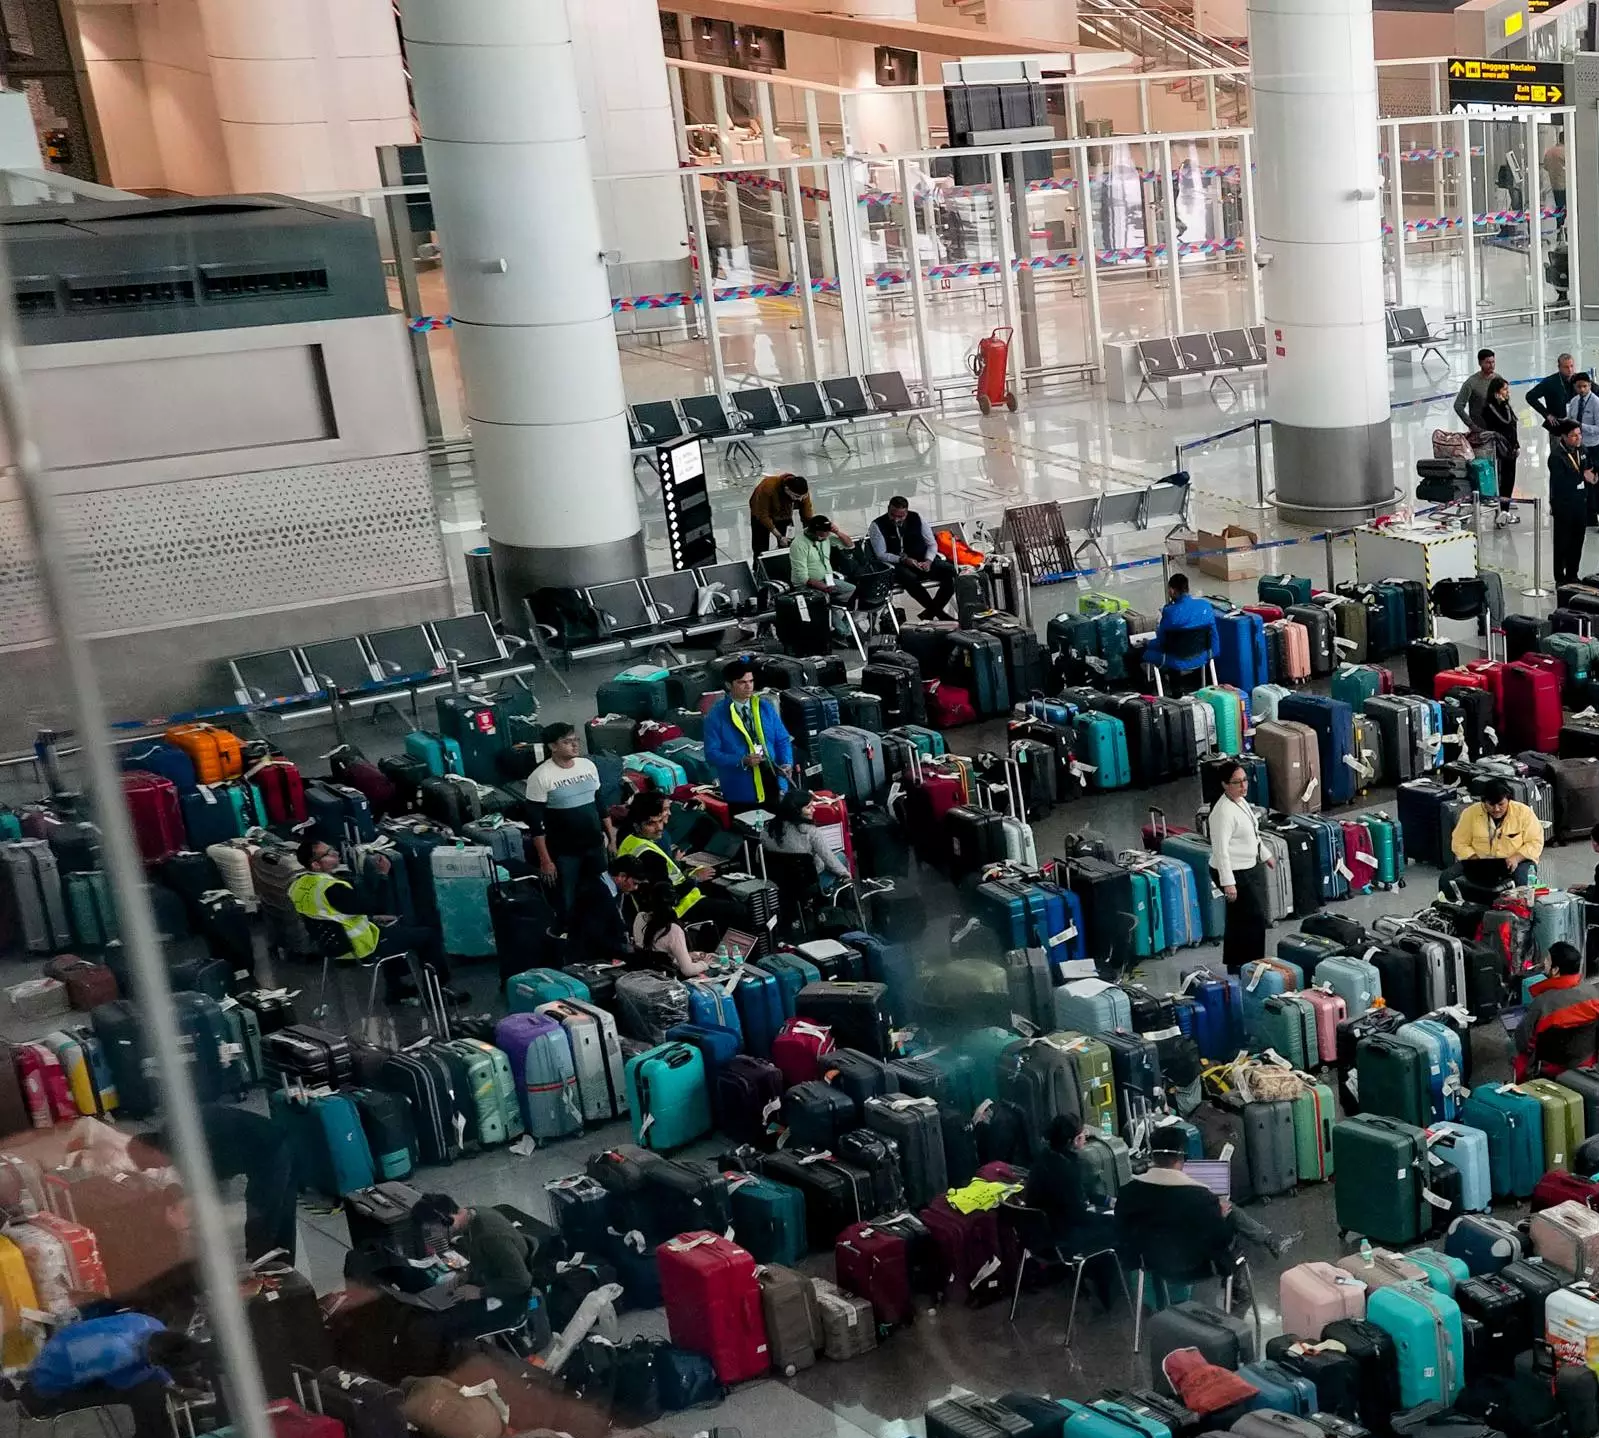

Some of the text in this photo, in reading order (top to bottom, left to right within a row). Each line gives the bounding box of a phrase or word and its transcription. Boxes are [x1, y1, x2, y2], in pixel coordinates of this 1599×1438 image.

[1481, 62, 1537, 72] Baggage Reclaim
[1517, 85, 1530, 93] Exit
